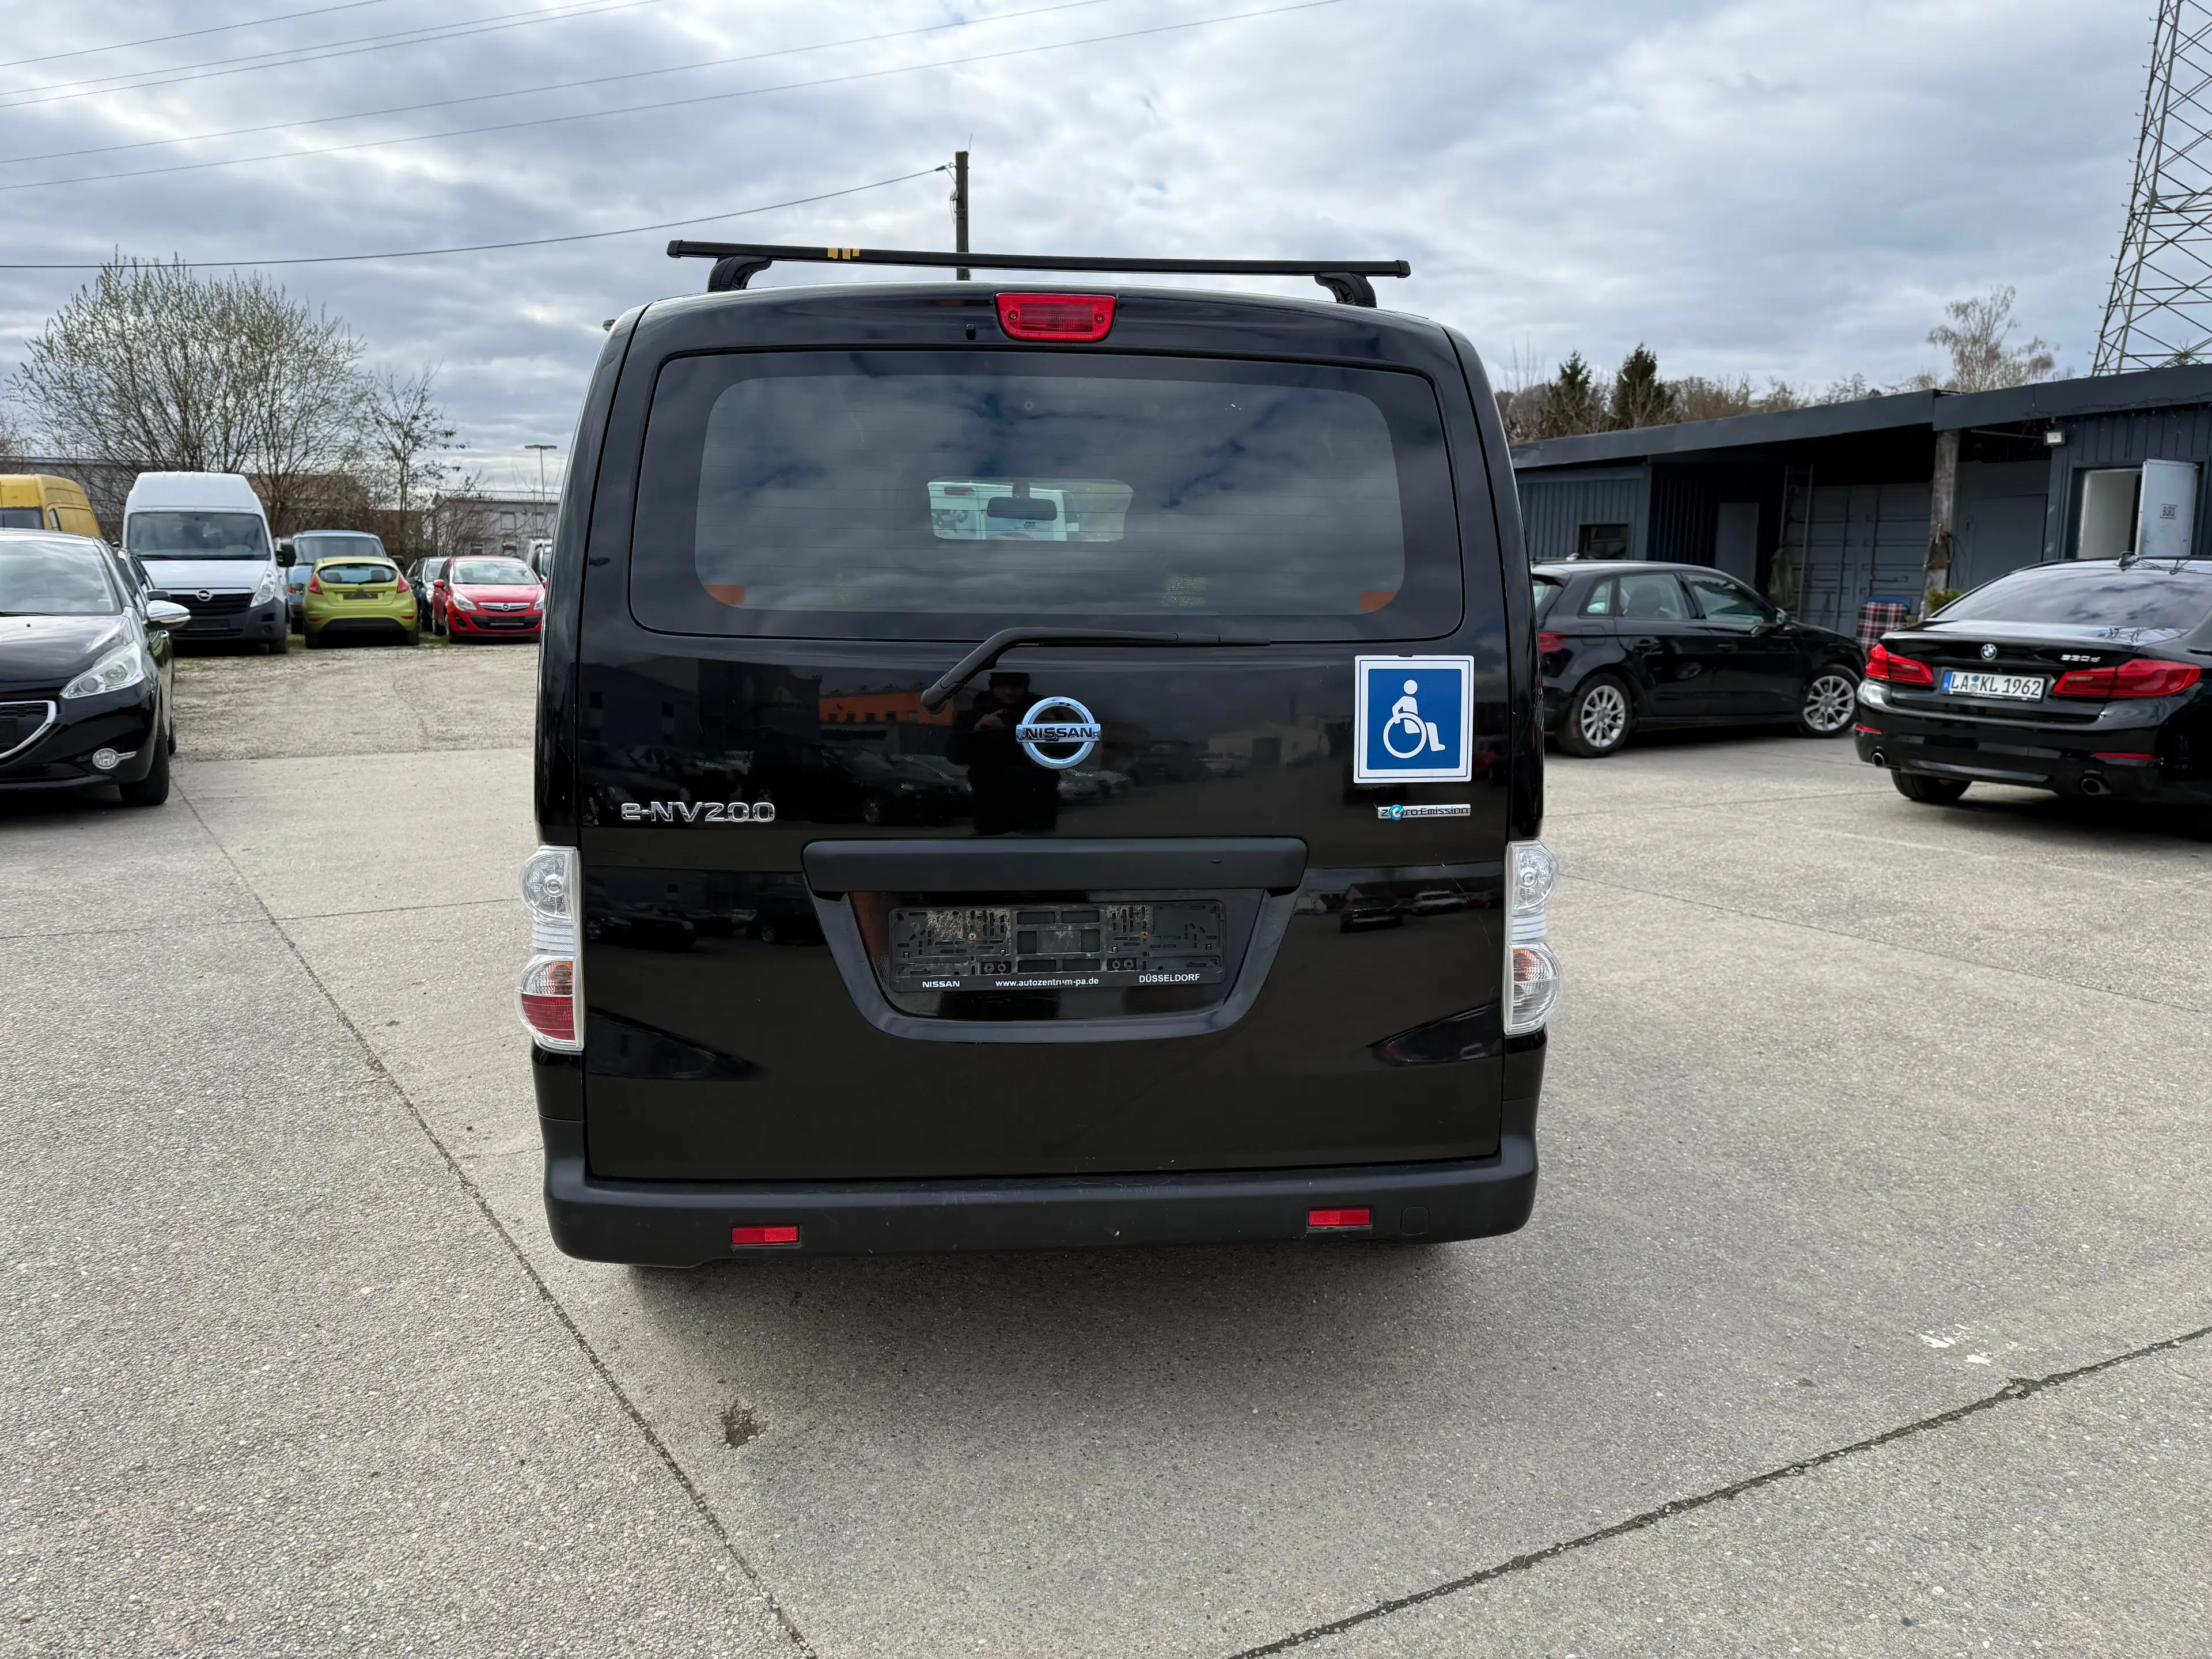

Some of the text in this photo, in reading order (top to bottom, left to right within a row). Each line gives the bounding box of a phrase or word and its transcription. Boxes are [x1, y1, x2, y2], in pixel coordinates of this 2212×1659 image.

[1950, 673, 1969, 690] LA
[1979, 676, 1998, 692] KL
[2001, 677, 2041, 696] 1962
[1025, 727, 1093, 738] NISSAN
[621, 801, 775, 823] e-NV200
[995, 977, 1099, 987] www.autozentrum-pa.de
[1139, 974, 1200, 983] DÜSSELDORF
